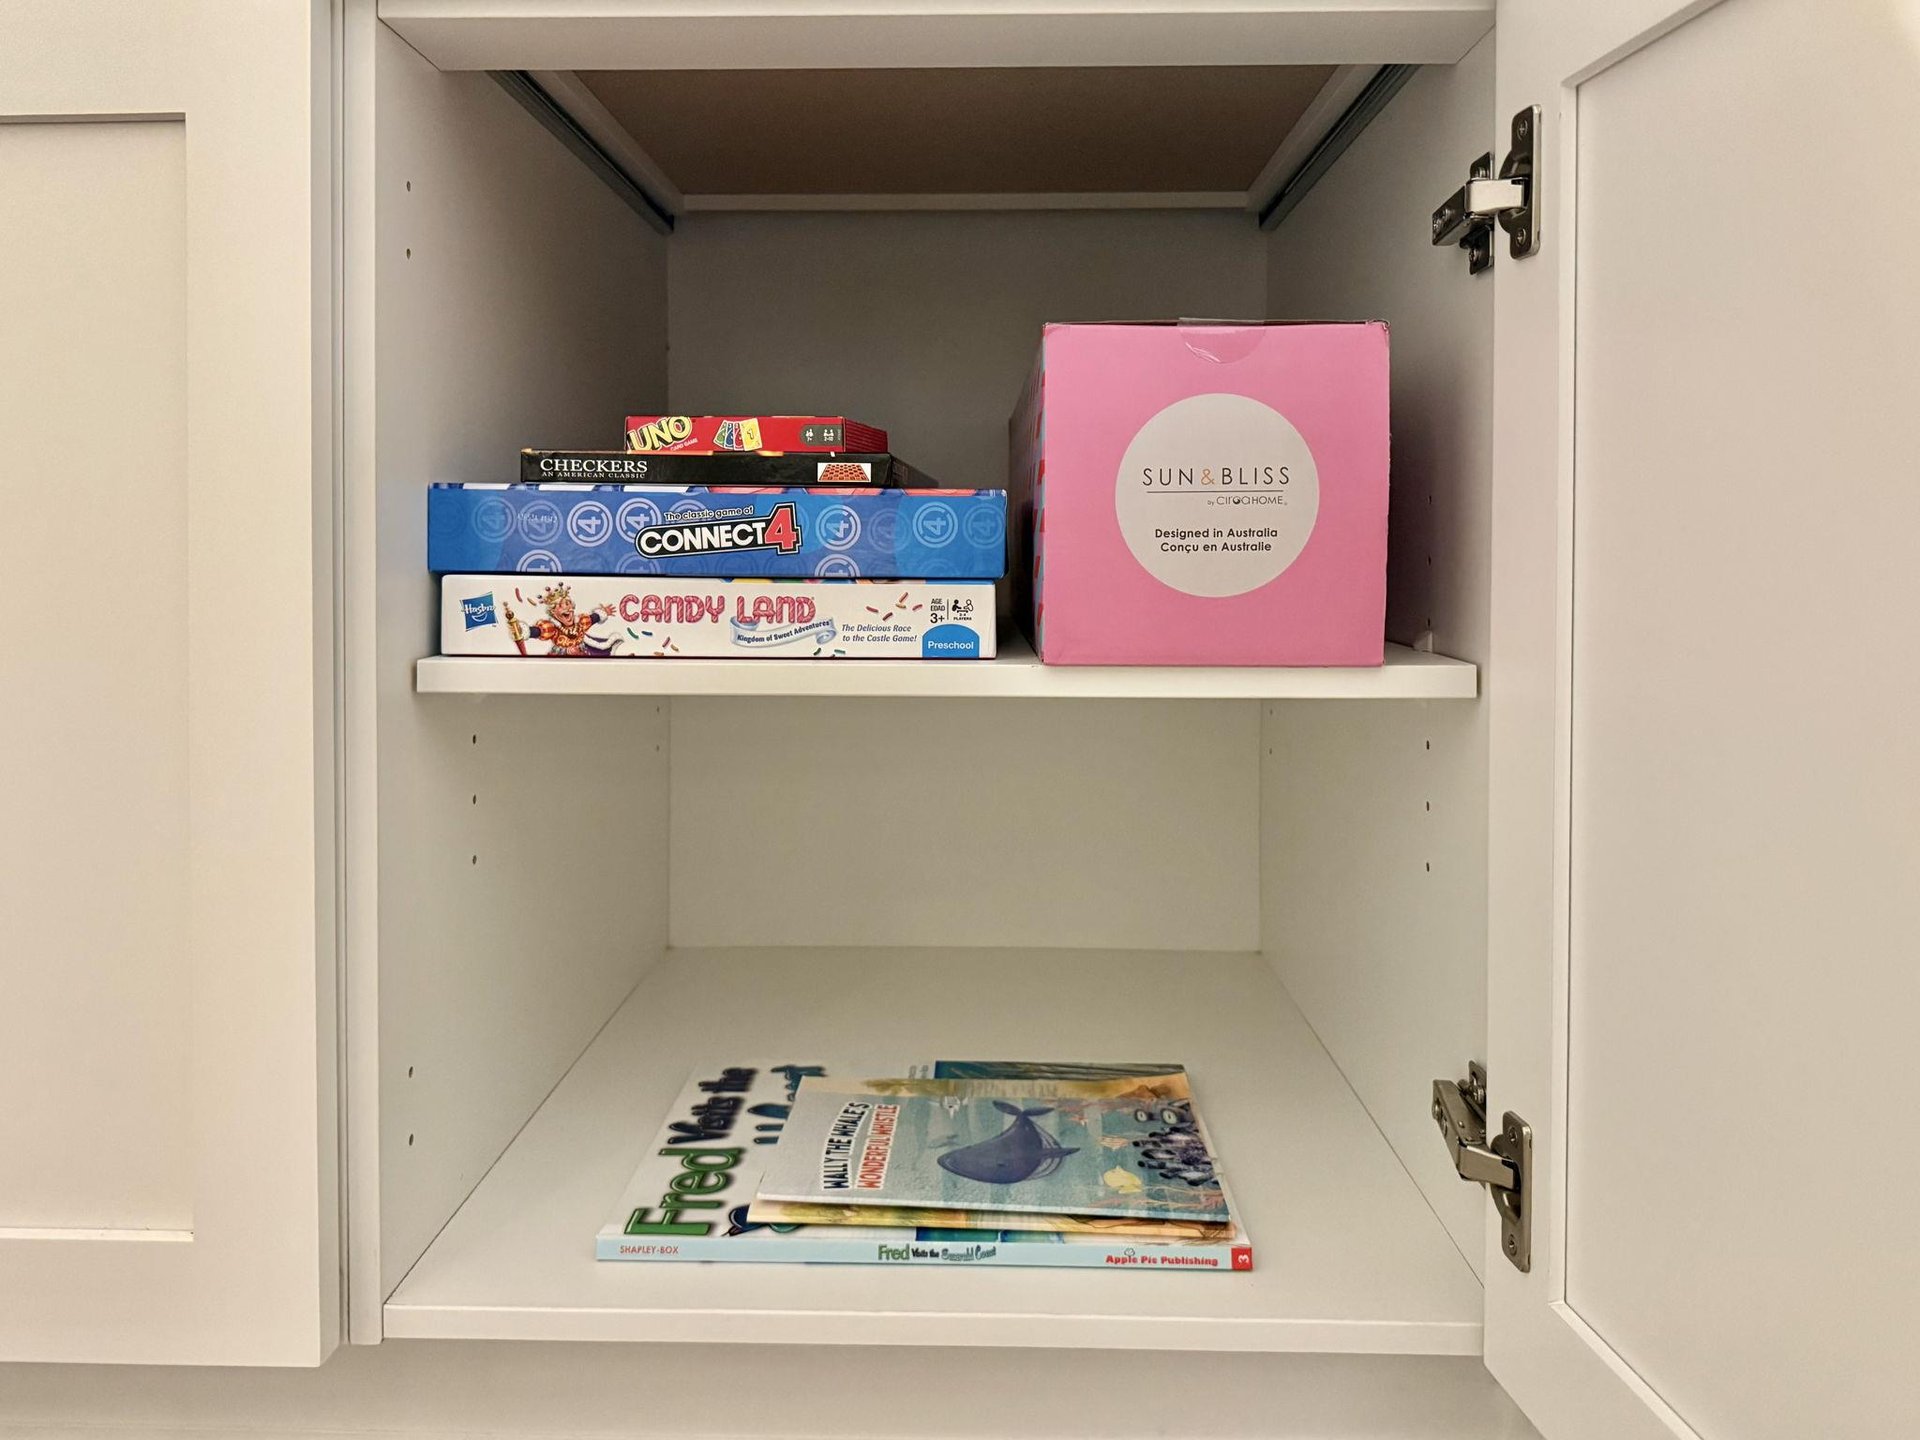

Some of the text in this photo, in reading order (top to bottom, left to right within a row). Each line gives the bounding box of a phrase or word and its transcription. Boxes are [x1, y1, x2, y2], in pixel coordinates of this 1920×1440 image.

[628, 416, 692, 450] UNO
[540, 458, 648, 473] CHECKERS
[664, 505, 754, 521] The classic game of
[640, 507, 797, 553] CONNECT 4
[1155, 527, 1278, 540] Designed in Australia
[1160, 541, 1272, 553] Conçu en Australie
[463, 603, 496, 615] Hasbro
[619, 594, 817, 623] CANDY LAND
[930, 612, 945, 624] 3+
[737, 620, 830, 643] Kingdom of Sweet Adventures
[842, 624, 912, 632] The Delicious Race
[866, 634, 891, 642] Castle
[927, 640, 974, 650] Preschool
[825, 1138, 853, 1155] THE
[857, 1105, 898, 1188] WONDERFUL WHISTLE
[823, 1157, 850, 1189] WALLY
[624, 1148, 743, 1235] Fred
[620, 1245, 679, 1254] SHAPLEY-BOX
[878, 1243, 910, 1260] Fred
[1105, 1254, 1219, 1266] Apple Pie Publishing
